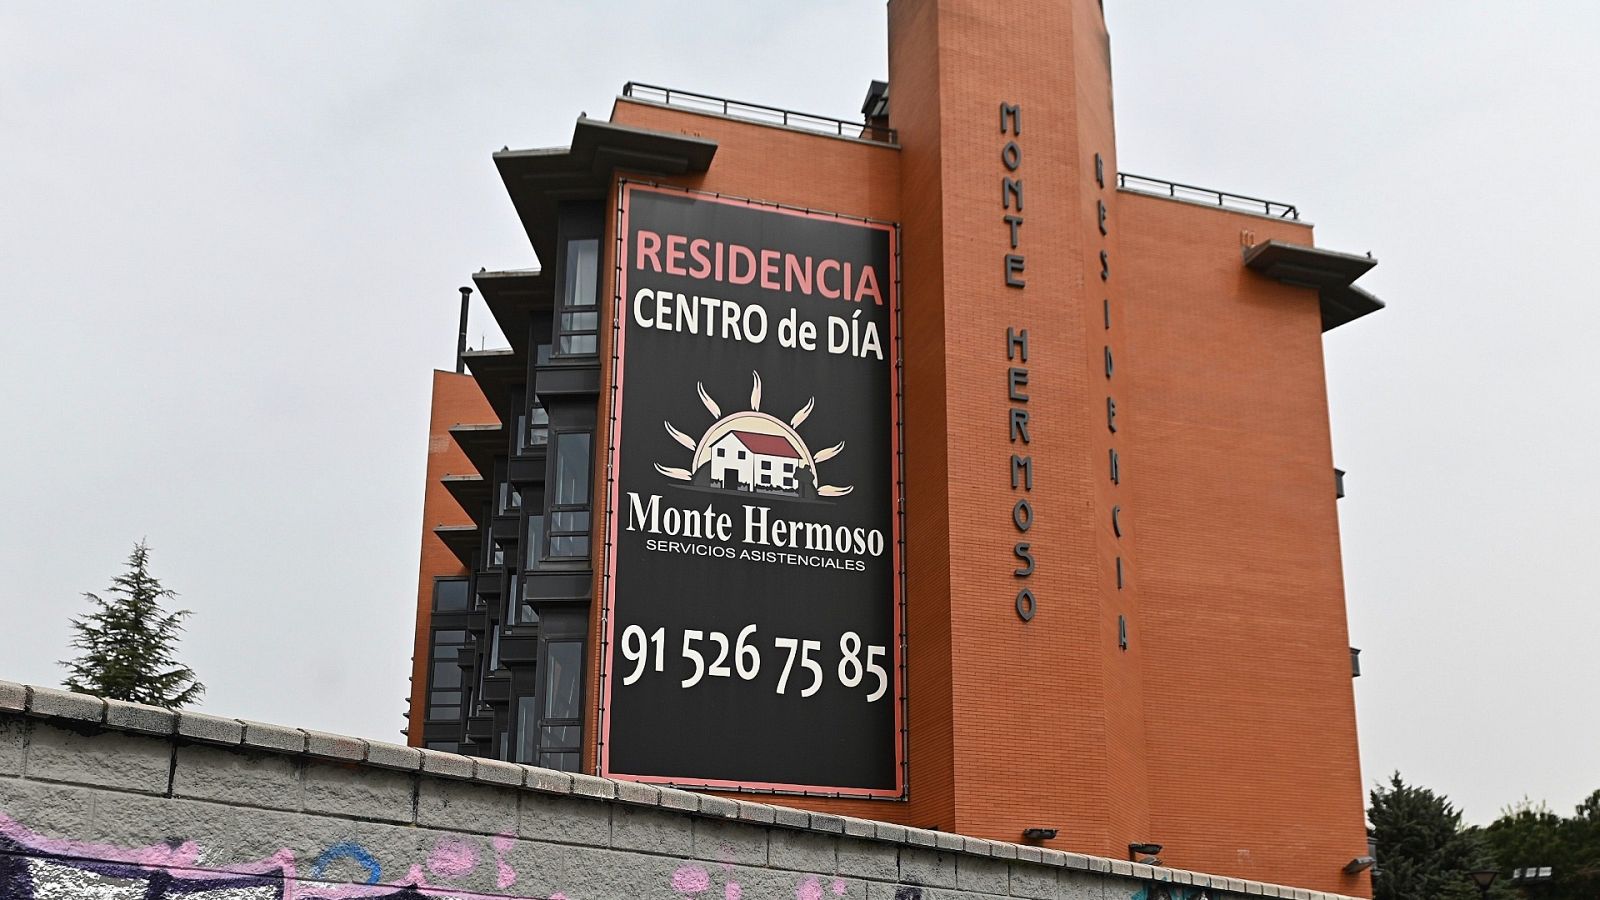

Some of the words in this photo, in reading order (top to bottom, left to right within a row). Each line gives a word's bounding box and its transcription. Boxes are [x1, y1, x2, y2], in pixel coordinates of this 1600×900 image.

[1000, 101, 1026, 288] MONTE
[636, 230, 883, 305] RESIDENCIA
[633, 288, 768, 343] CENTRO
[777, 307, 817, 351] de
[828, 309, 883, 360] DÍA
[1095, 152, 1127, 652] RESIDENCIA
[1007, 326, 1036, 622] HERMOSO
[626, 492, 732, 541] Monte
[742, 504, 884, 557] Hermoso
[646, 539, 736, 559] SERVICIOS
[739, 549, 866, 571] ASISTENCIALES
[621, 624, 665, 686] 91
[681, 624, 761, 688] 526
[774, 637, 823, 698] 75
[838, 631, 888, 703] 85
